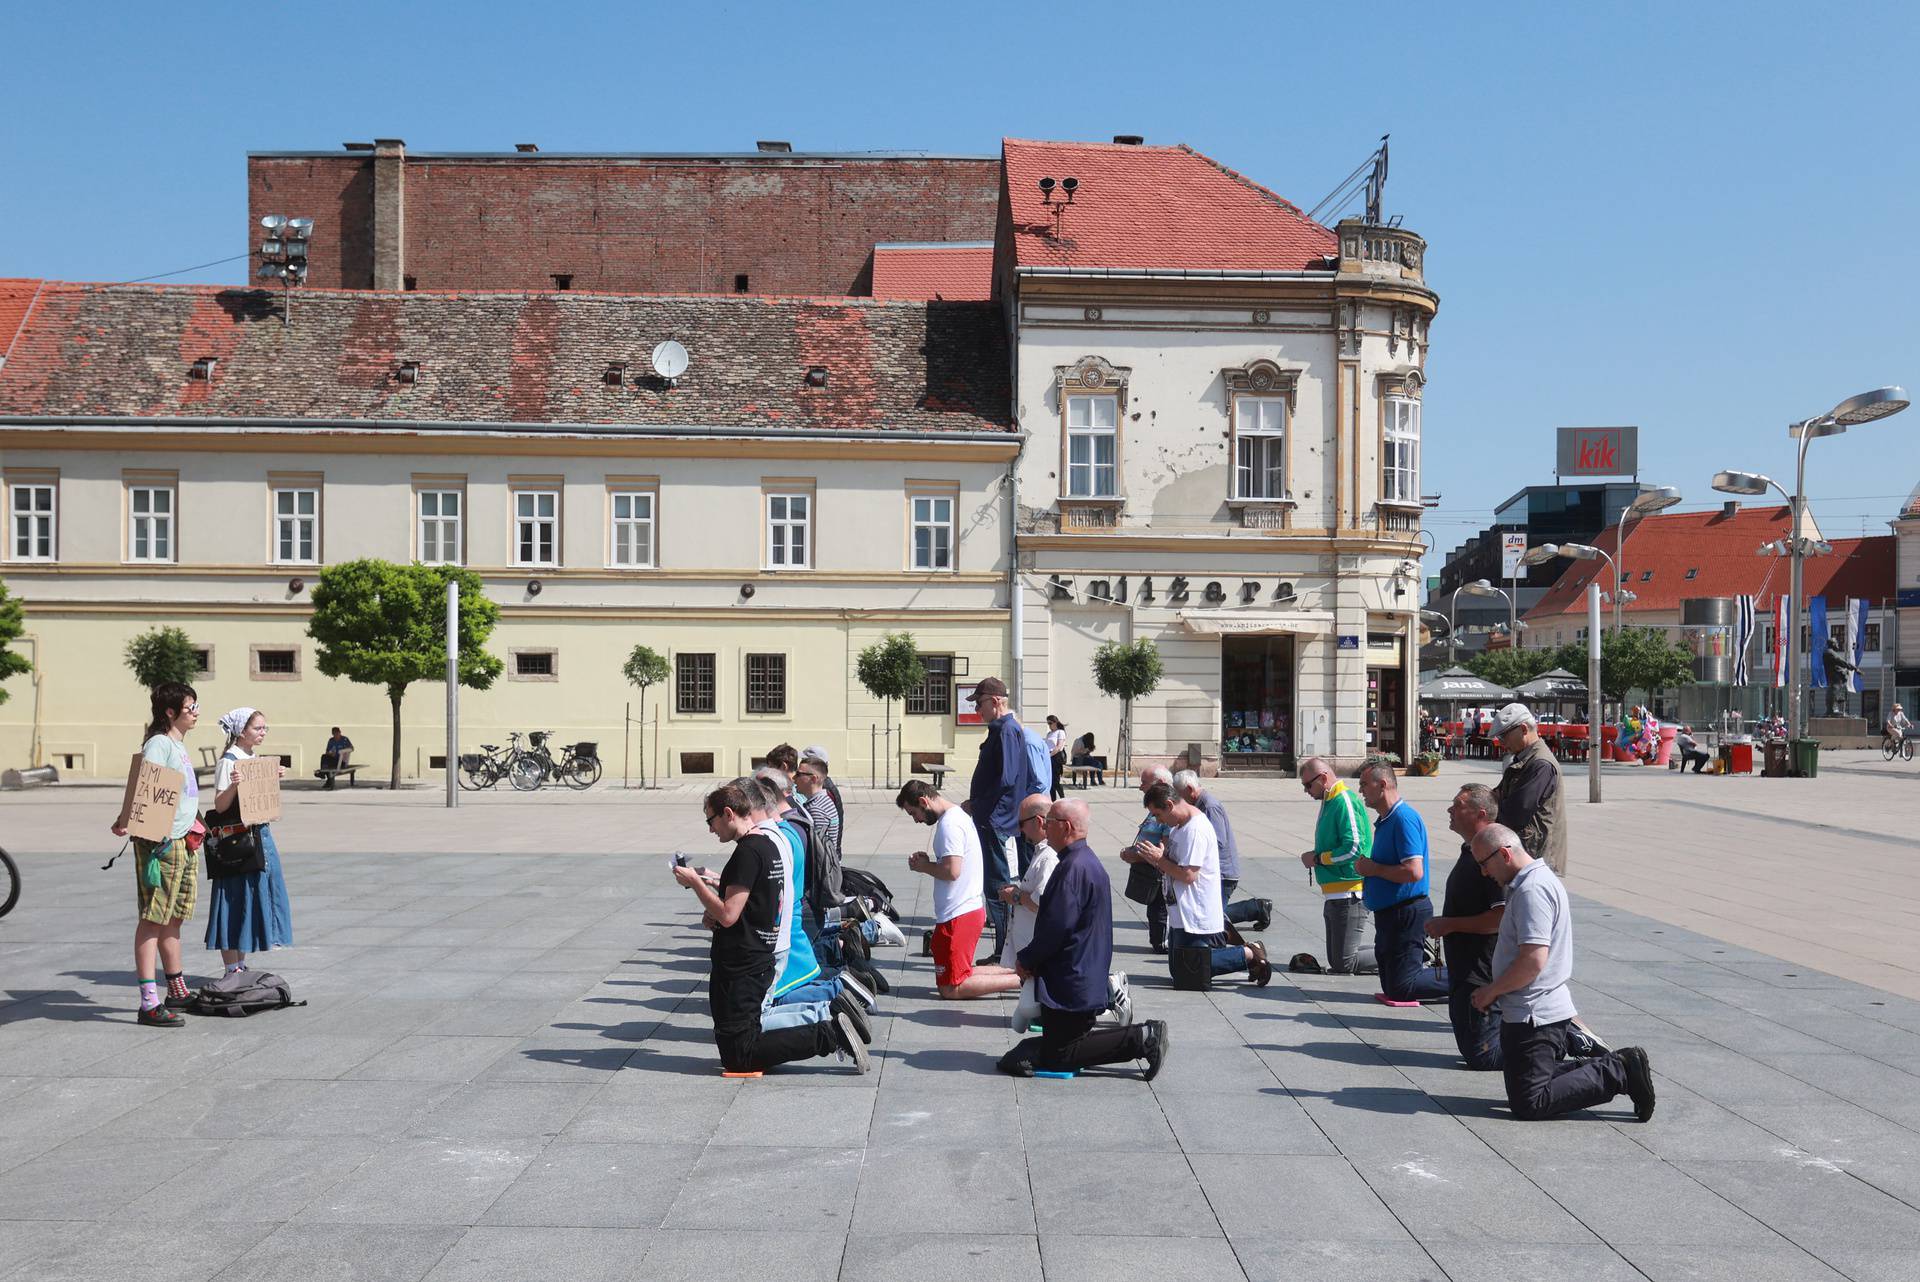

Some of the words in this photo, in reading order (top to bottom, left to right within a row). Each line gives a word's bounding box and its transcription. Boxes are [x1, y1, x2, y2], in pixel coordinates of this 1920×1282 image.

[1578, 434, 1616, 468] kik
[1508, 536, 1523, 544] dm
[1050, 575, 1298, 605] knjižara
[147, 766, 161, 783] MI
[136, 780, 149, 799] ZA
